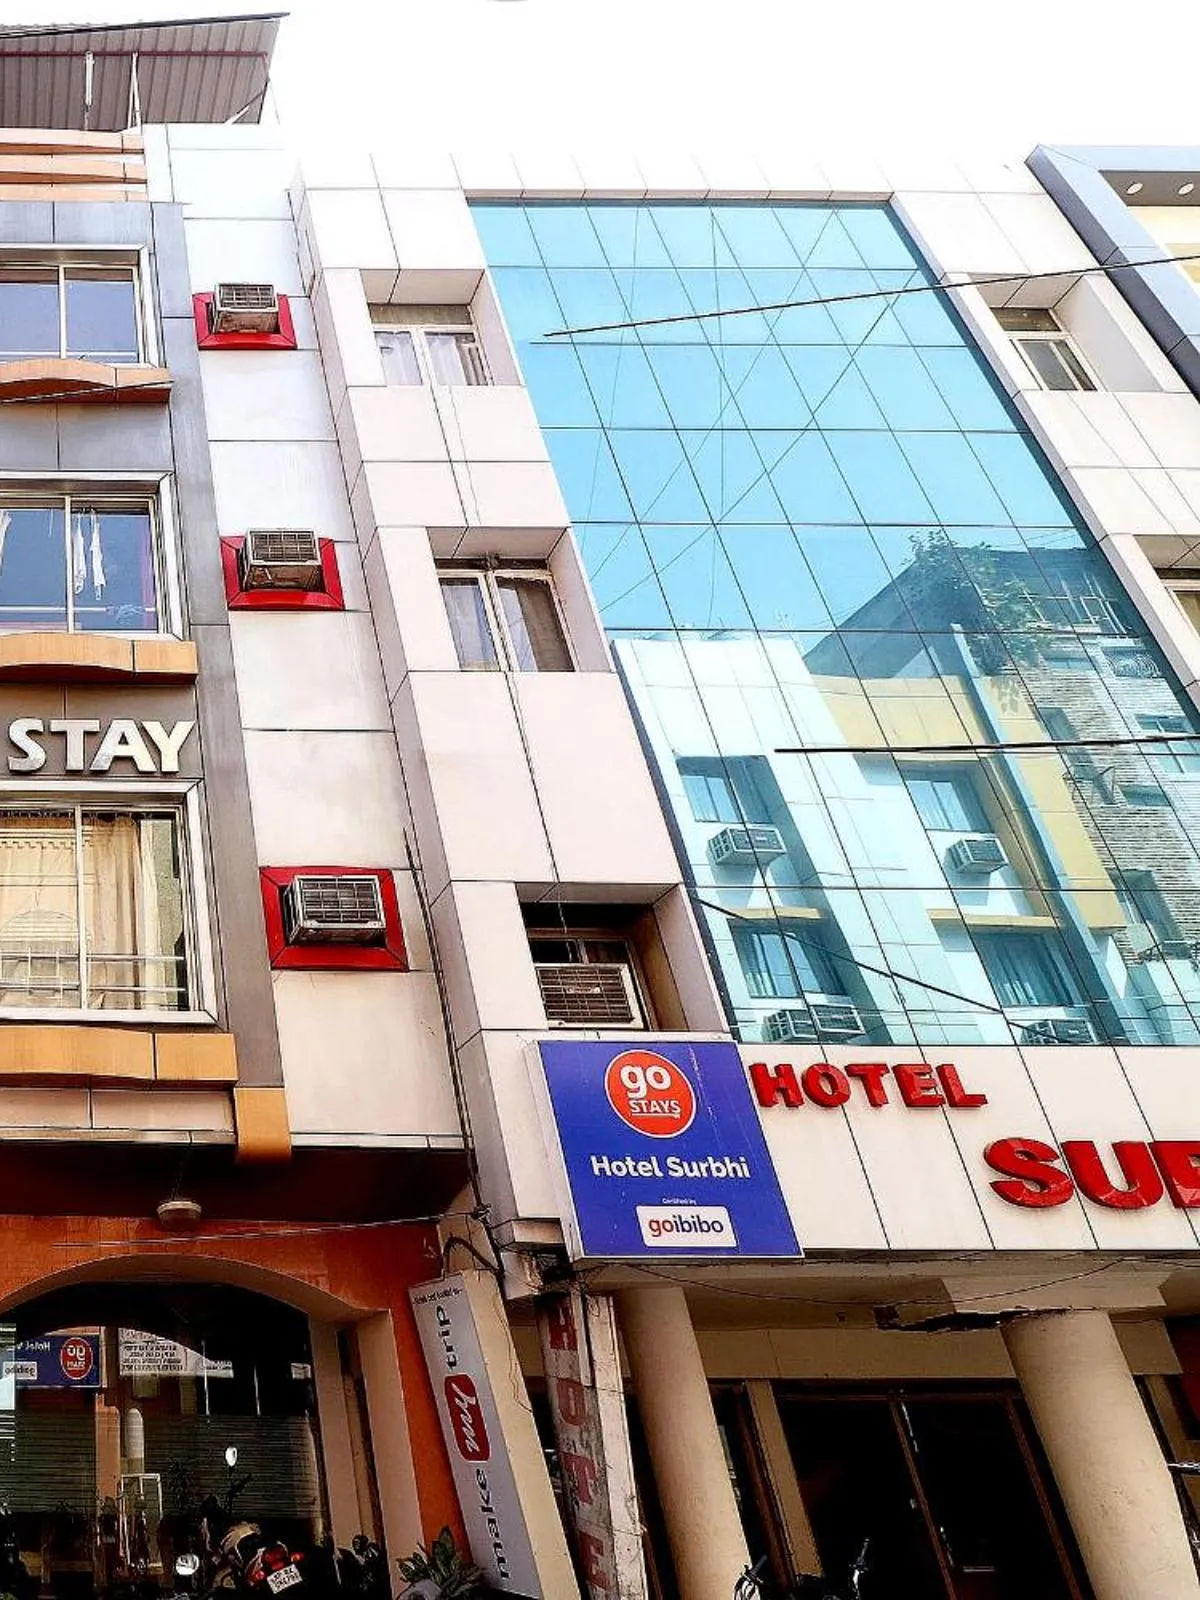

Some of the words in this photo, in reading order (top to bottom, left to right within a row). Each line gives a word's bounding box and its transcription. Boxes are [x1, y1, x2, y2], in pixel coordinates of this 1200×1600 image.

[6, 717, 196, 773] STAY
[620, 1064, 671, 1098] go
[749, 1062, 988, 1108] HOTEL
[629, 1099, 682, 1114] STAYS
[590, 1155, 663, 1178] Hotel
[667, 1156, 751, 1178] Surbhi
[648, 1214, 724, 1237] goibibo
[436, 1304, 458, 1370] trip
[451, 1382, 479, 1453] my
[476, 1467, 513, 1580] make
